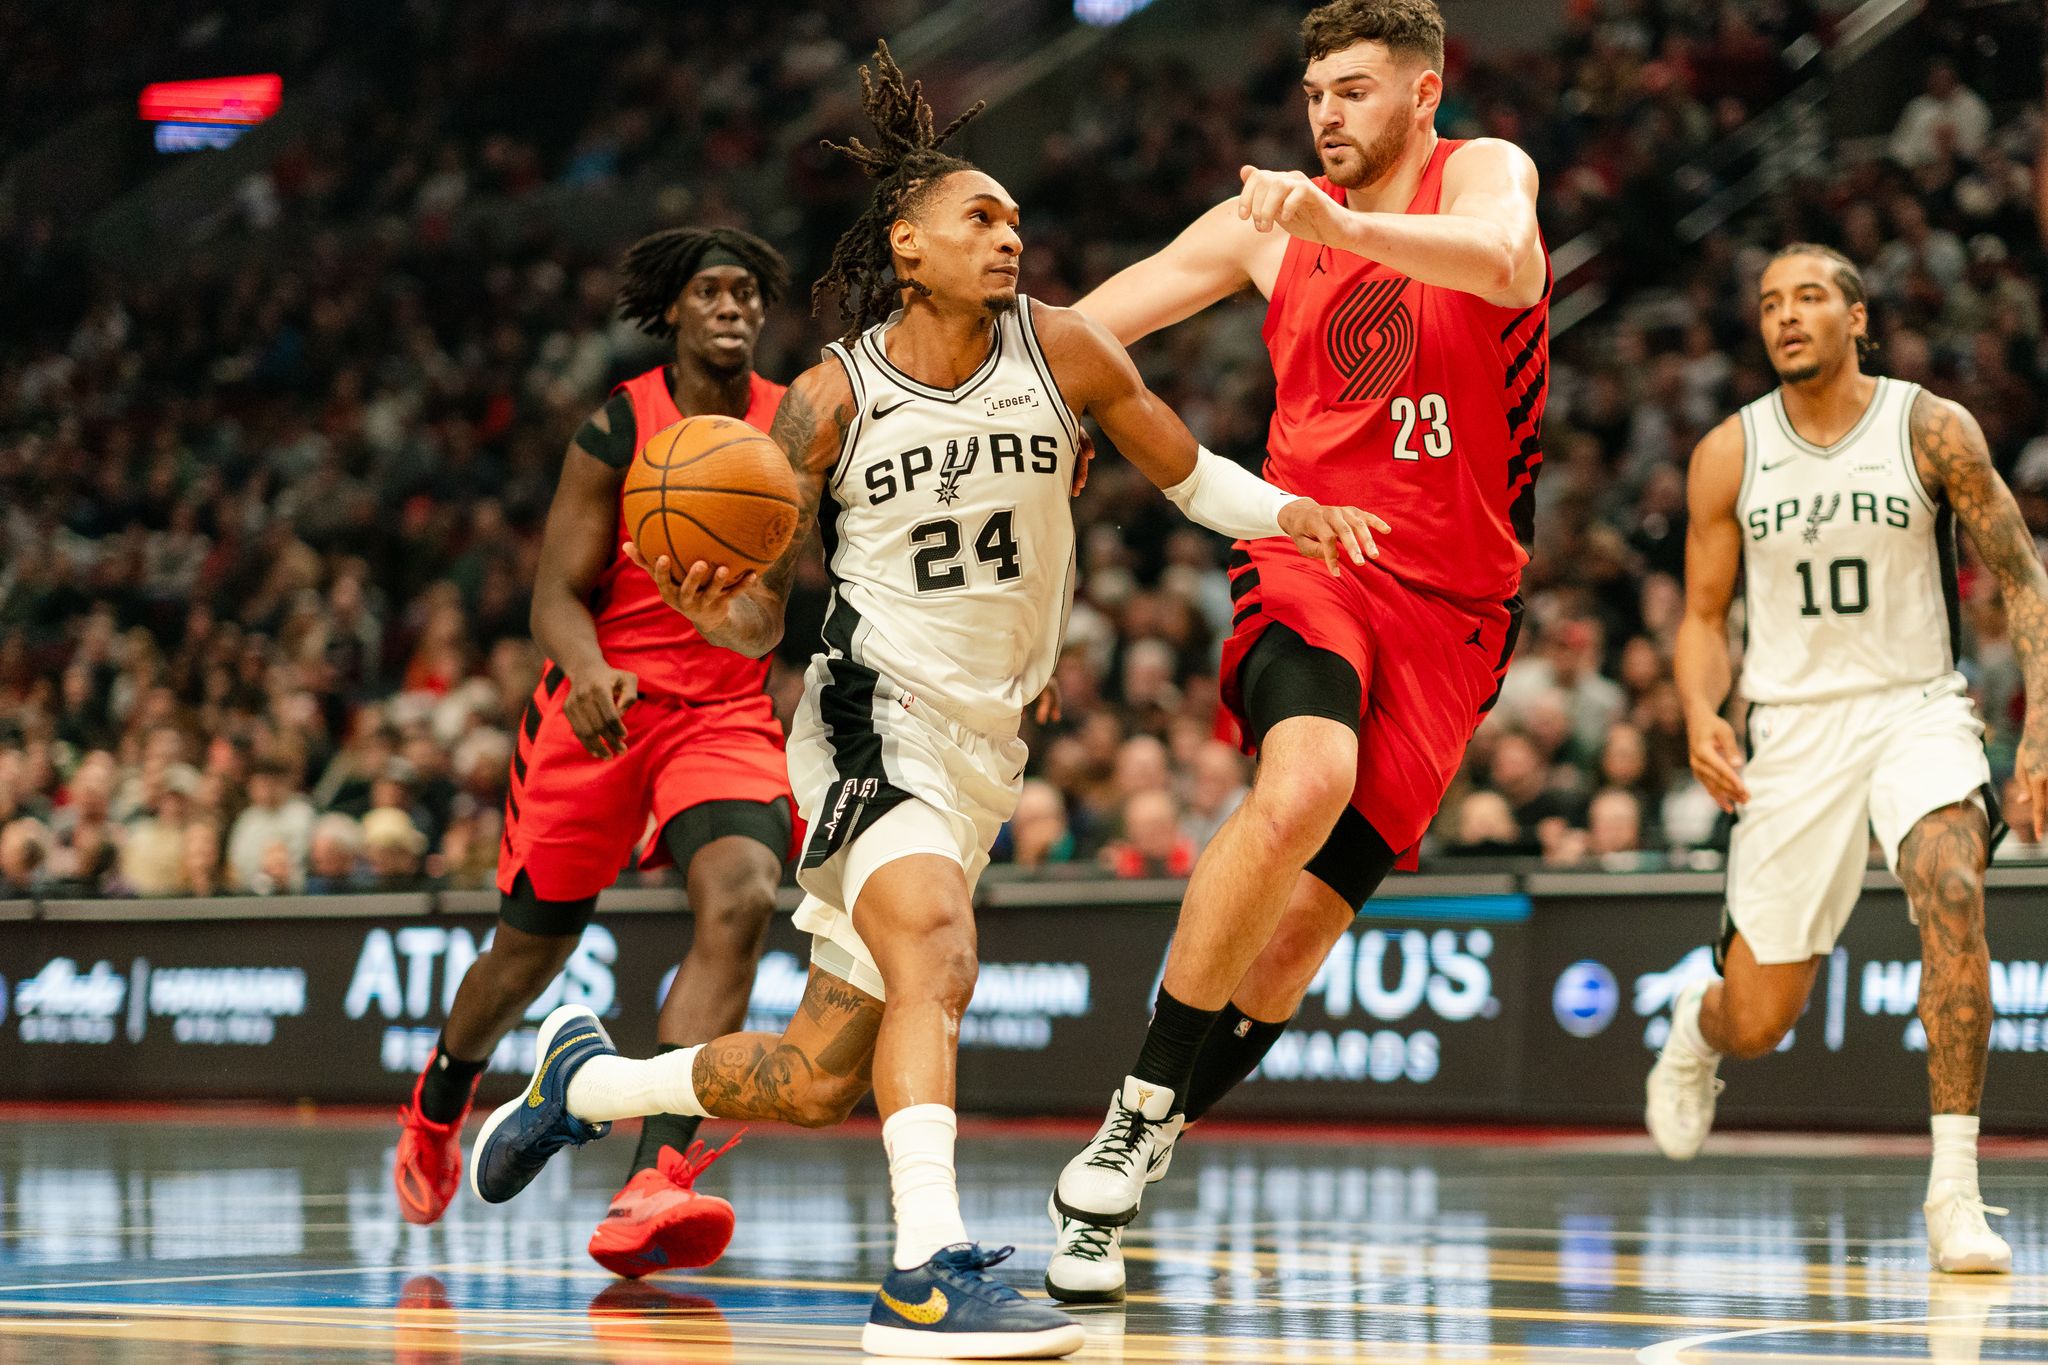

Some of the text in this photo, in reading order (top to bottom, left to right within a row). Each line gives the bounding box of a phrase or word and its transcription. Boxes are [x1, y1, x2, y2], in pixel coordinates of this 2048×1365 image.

[991, 394, 1032, 410] LEDGER
[1390, 392, 1454, 462] 23
[865, 433, 1058, 506] SPURS
[1749, 491, 1910, 543] SPURS
[908, 506, 1023, 596] 24
[1796, 558, 1869, 616] 10
